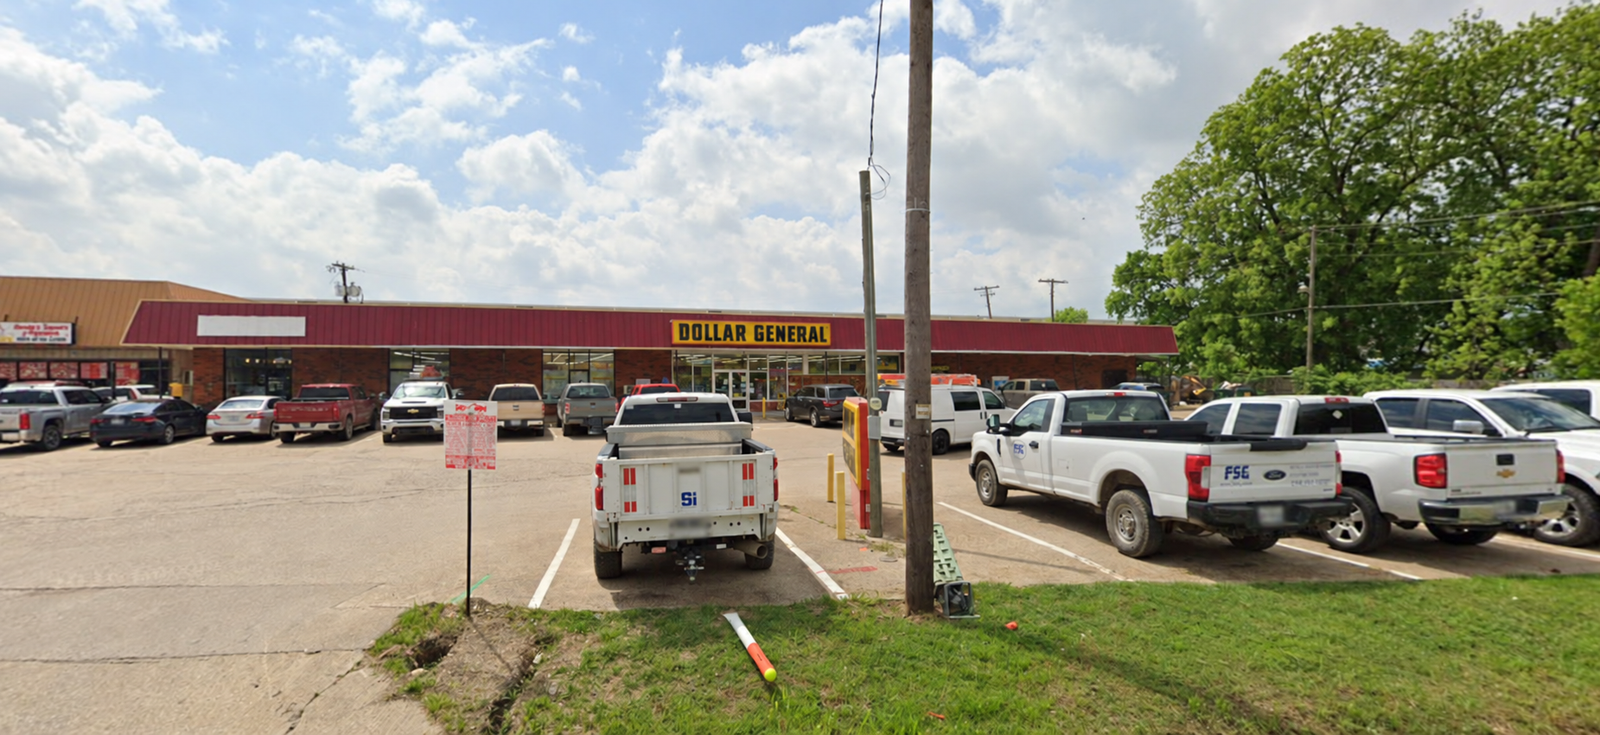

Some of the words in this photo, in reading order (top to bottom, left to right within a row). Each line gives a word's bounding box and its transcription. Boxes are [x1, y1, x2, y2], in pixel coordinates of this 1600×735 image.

[678, 323, 747, 342] DOLLAR
[754, 324, 828, 343] GENERAL
[1224, 465, 1250, 480] FSG
[681, 491, 697, 507] Si
